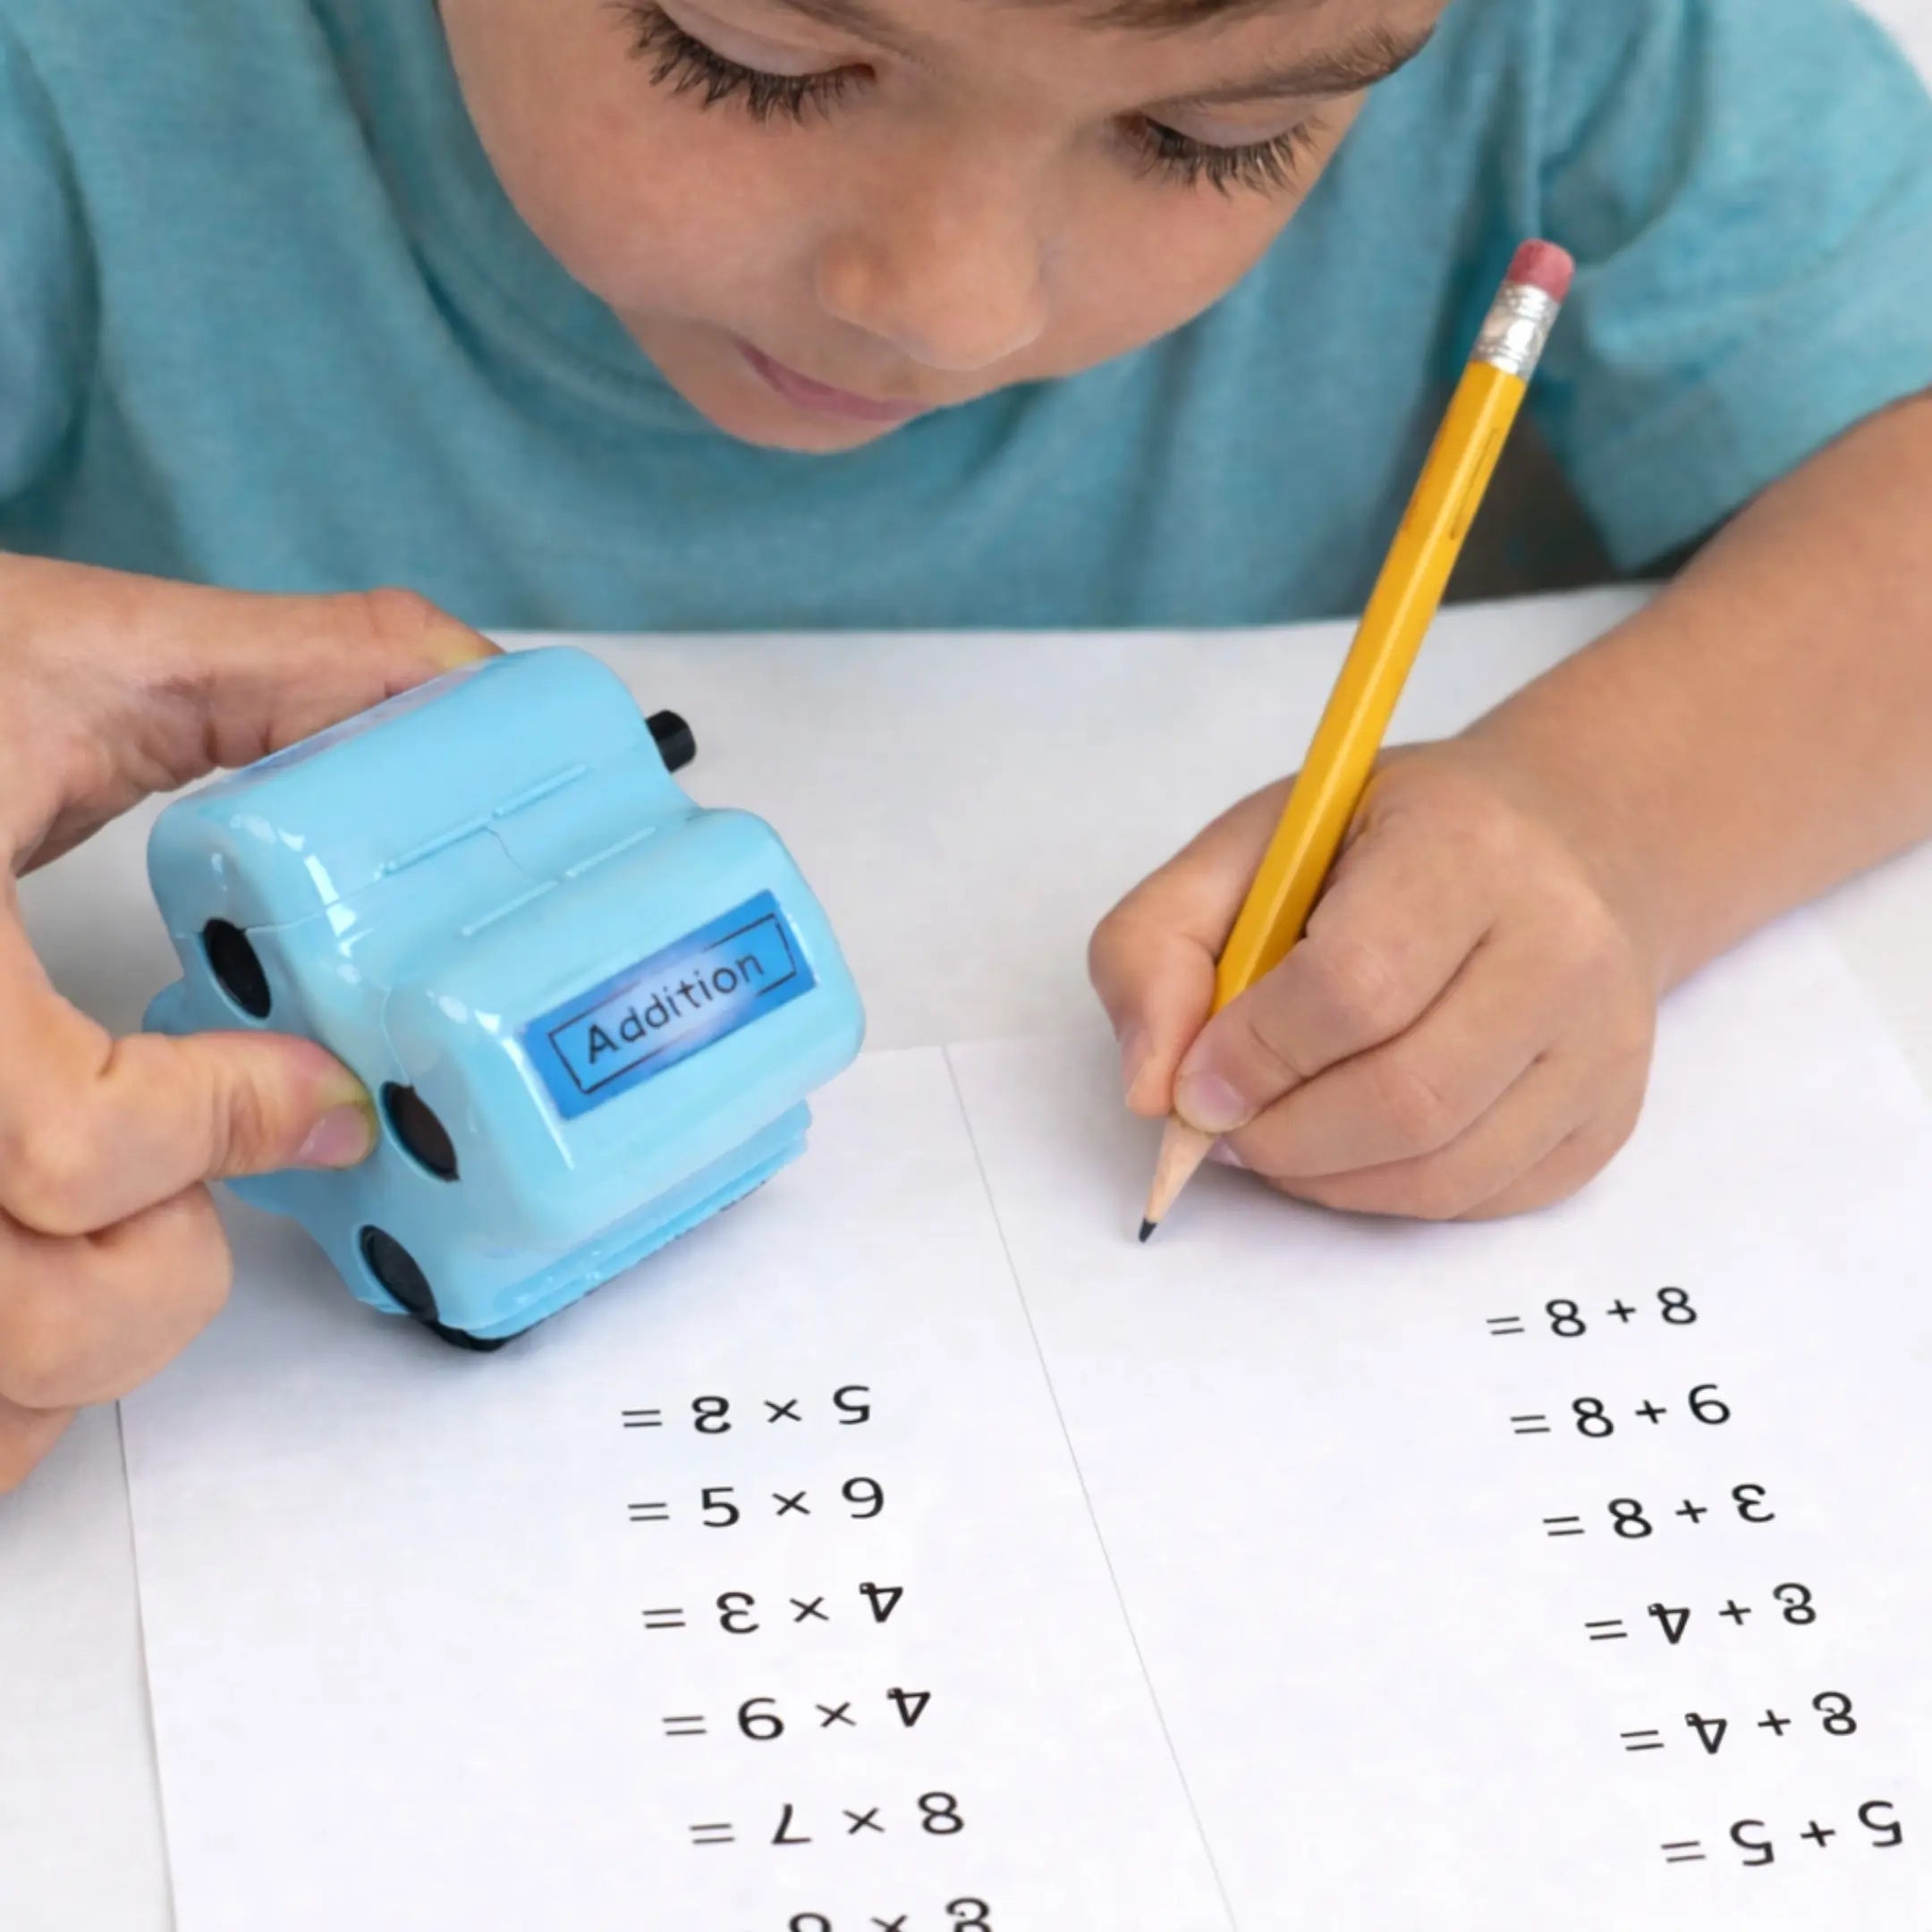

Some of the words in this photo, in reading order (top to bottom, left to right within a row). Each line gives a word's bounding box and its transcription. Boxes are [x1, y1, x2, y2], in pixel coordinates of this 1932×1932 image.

[587, 952, 766, 1065] Addition
[1546, 1299, 1587, 1337] 8
[1607, 1300, 1636, 1323] +
[1657, 1286, 1698, 1326] 8
[1487, 1317, 1524, 1335] =
[622, 1410, 662, 1428] =
[833, 1385, 870, 1425] 5
[1572, 1397, 1614, 1438] 8
[1635, 1400, 1667, 1424] +
[1511, 1415, 1550, 1434] =
[628, 1503, 669, 1521] =
[701, 1487, 740, 1528] 5
[1608, 1498, 1653, 1539] 8
[1675, 1499, 1707, 1524] +
[1732, 1484, 1775, 1523] 3
[1543, 1516, 1584, 1537] =
[716, 1591, 759, 1634] 3
[859, 1581, 903, 1623] 4
[1718, 1599, 1751, 1625] +
[643, 1608, 685, 1629] =
[1585, 1620, 1628, 1640] =
[1648, 1603, 1690, 1645] 4
[886, 1687, 931, 1727] 4
[1758, 1709, 1791, 1736] +
[664, 1716, 706, 1735] =
[1620, 1730, 1664, 1751] =
[1684, 1712, 1727, 1755] 4
[772, 1803, 811, 1845] 7
[918, 1792, 964, 1835] 8
[1858, 1801, 1902, 1848] 5
[691, 1824, 733, 1843] =
[1730, 1819, 1775, 1867] 5
[1801, 1820, 1835, 1847] +
[1662, 1841, 1705, 1862] =
